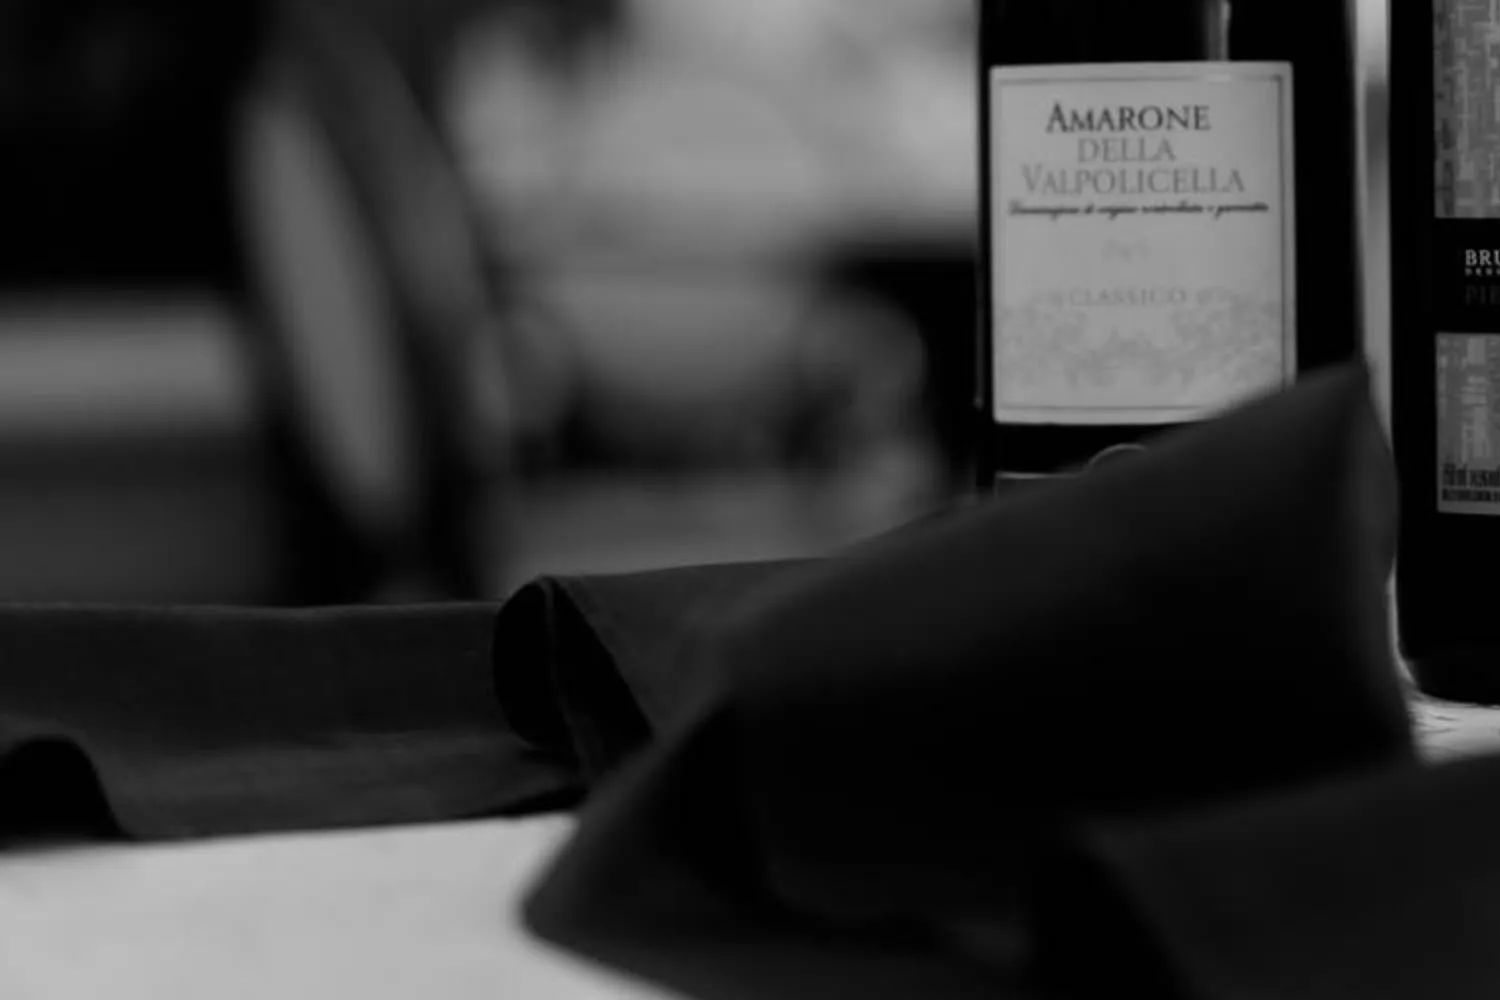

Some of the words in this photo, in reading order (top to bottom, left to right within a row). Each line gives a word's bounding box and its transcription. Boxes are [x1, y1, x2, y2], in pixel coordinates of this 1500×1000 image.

[1045, 101, 1212, 133] AMARONE
[1077, 137, 1177, 163] DELLA
[1021, 163, 1246, 195] VALPOLICELLA
